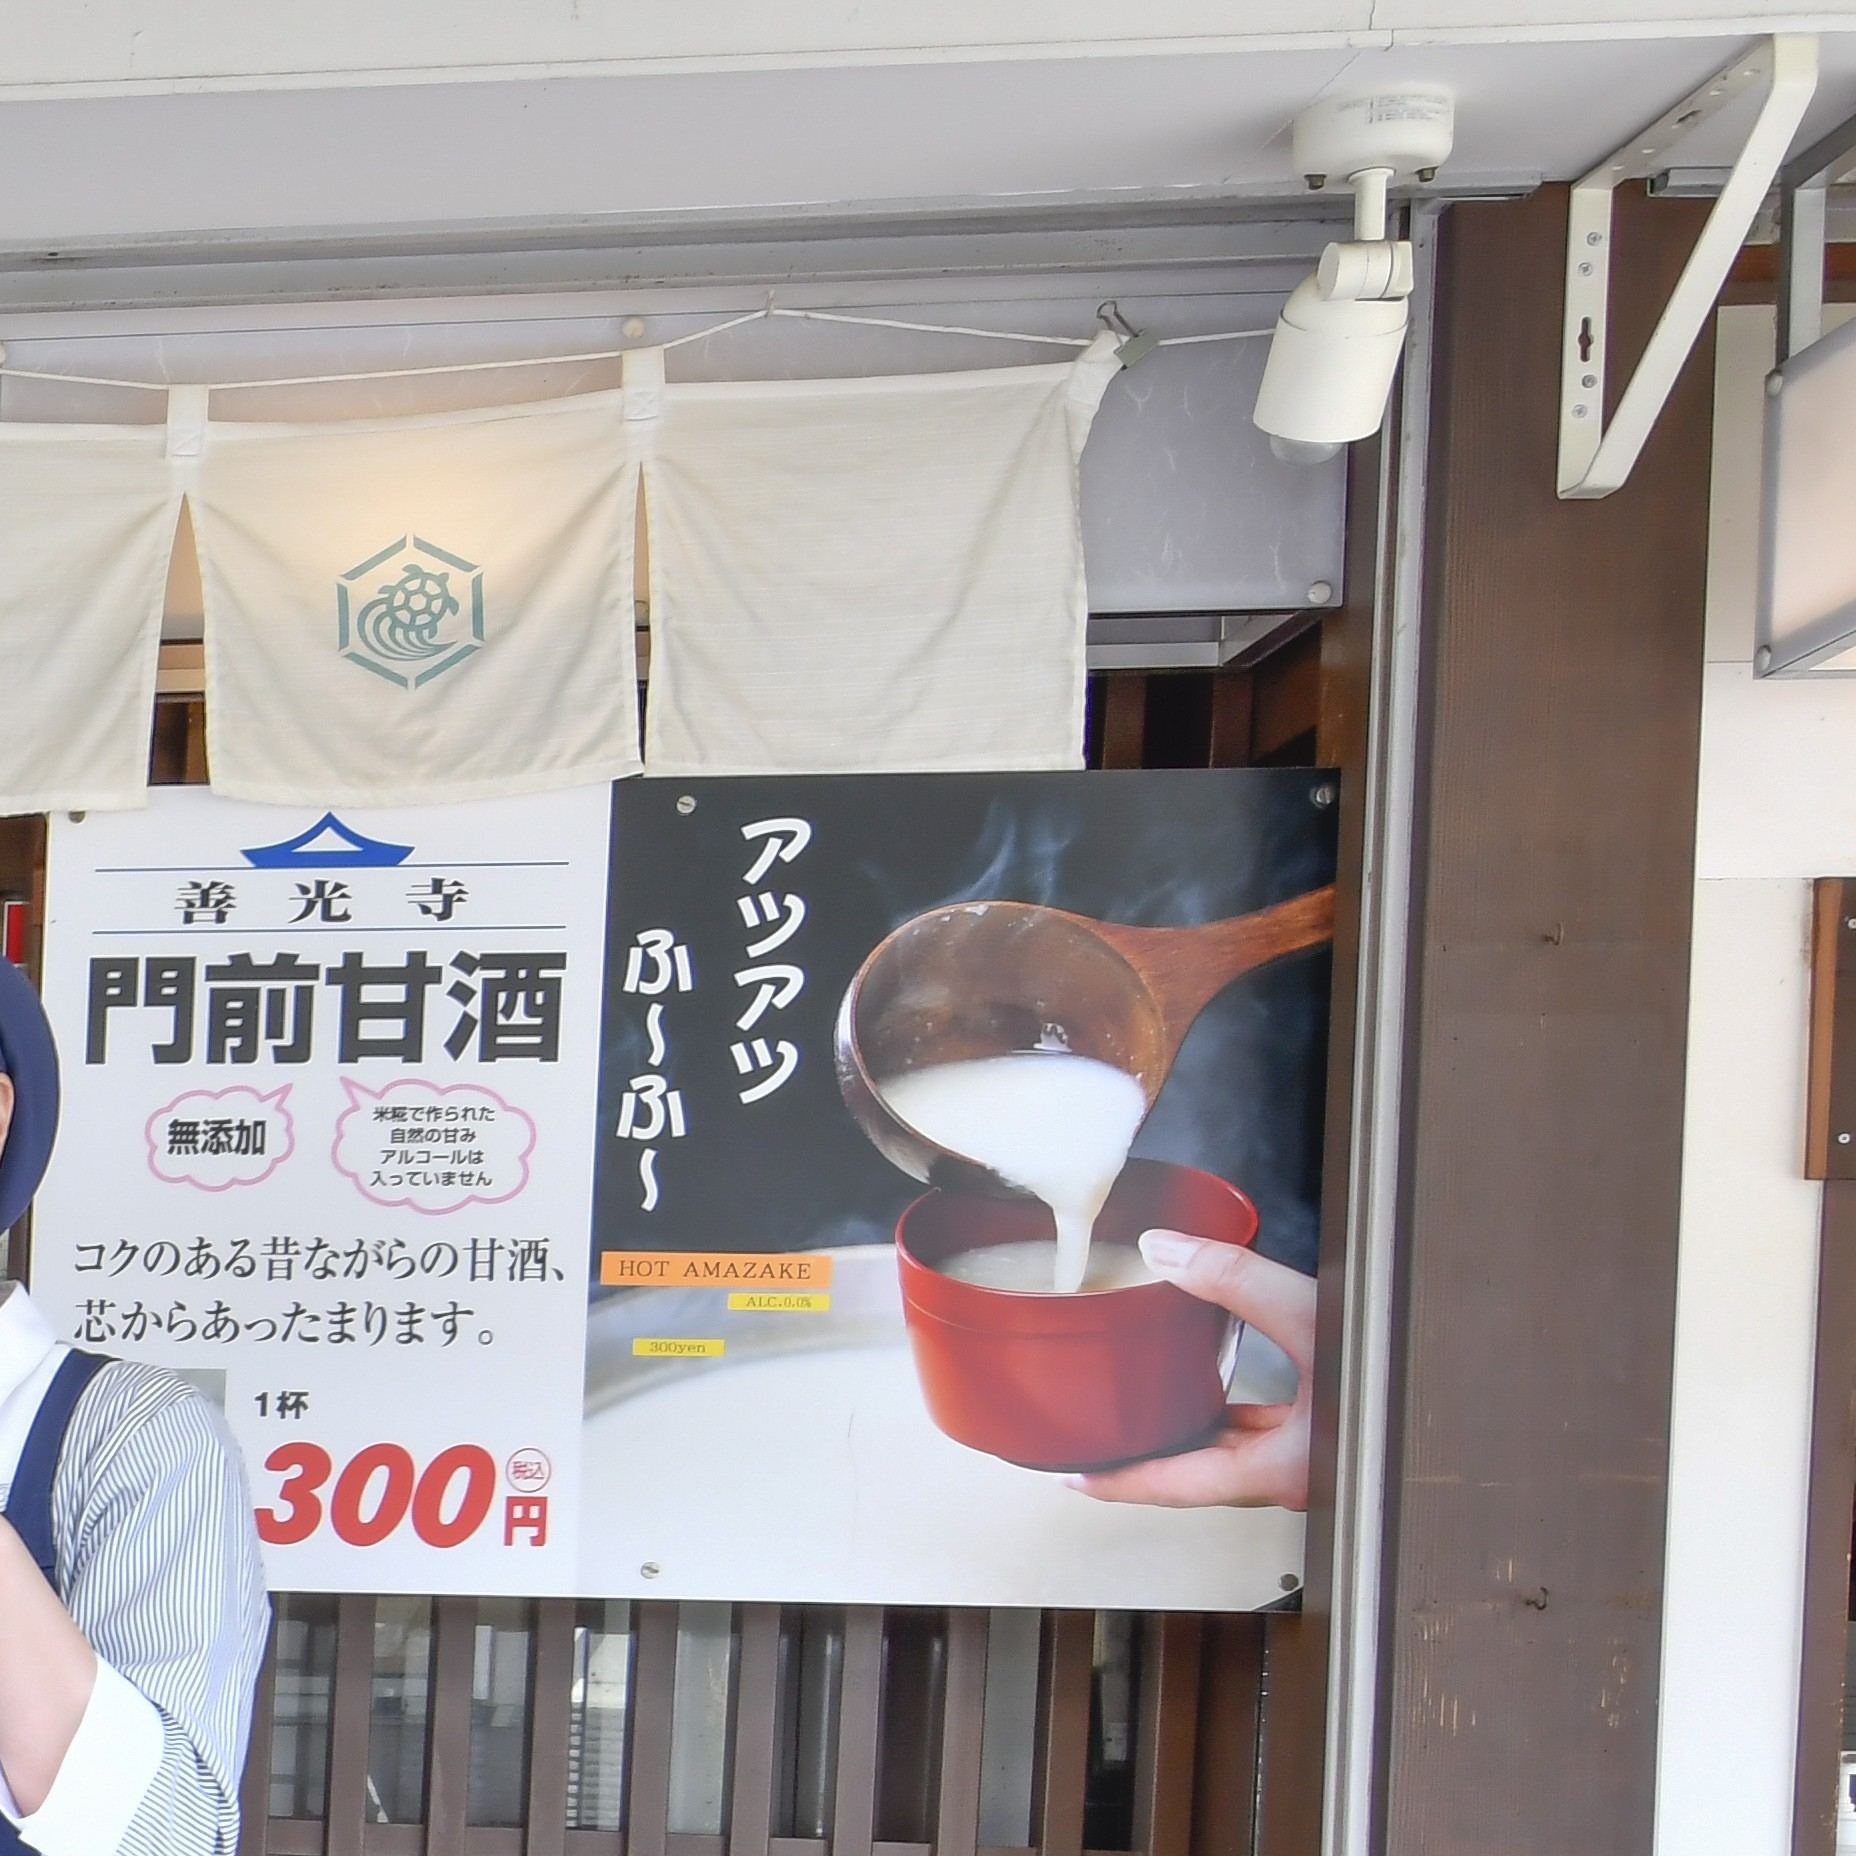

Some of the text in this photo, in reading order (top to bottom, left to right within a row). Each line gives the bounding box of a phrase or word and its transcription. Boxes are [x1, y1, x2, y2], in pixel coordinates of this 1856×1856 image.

[174, 876, 471, 925] 善光寺
[734, 816, 813, 1106] アツアツ
[84, 949, 568, 1066] 門前甘酒
[166, 1117, 268, 1157] 無添加
[389, 1125, 477, 1145] 自然の甘み
[379, 1147, 486, 1167] アルコールは
[369, 1167, 494, 1189] 入っていません
[73, 1235, 568, 1284] コクのある昔ながらの甘酒、
[618, 1260, 812, 1281] HOT AMAZAKE
[745, 1295, 813, 1309] ALC.0.0%
[73, 1298, 497, 1347] 芯からあったまります。
[648, 1341, 707, 1355] 300yen
[253, 1390, 310, 1421] 1杯
